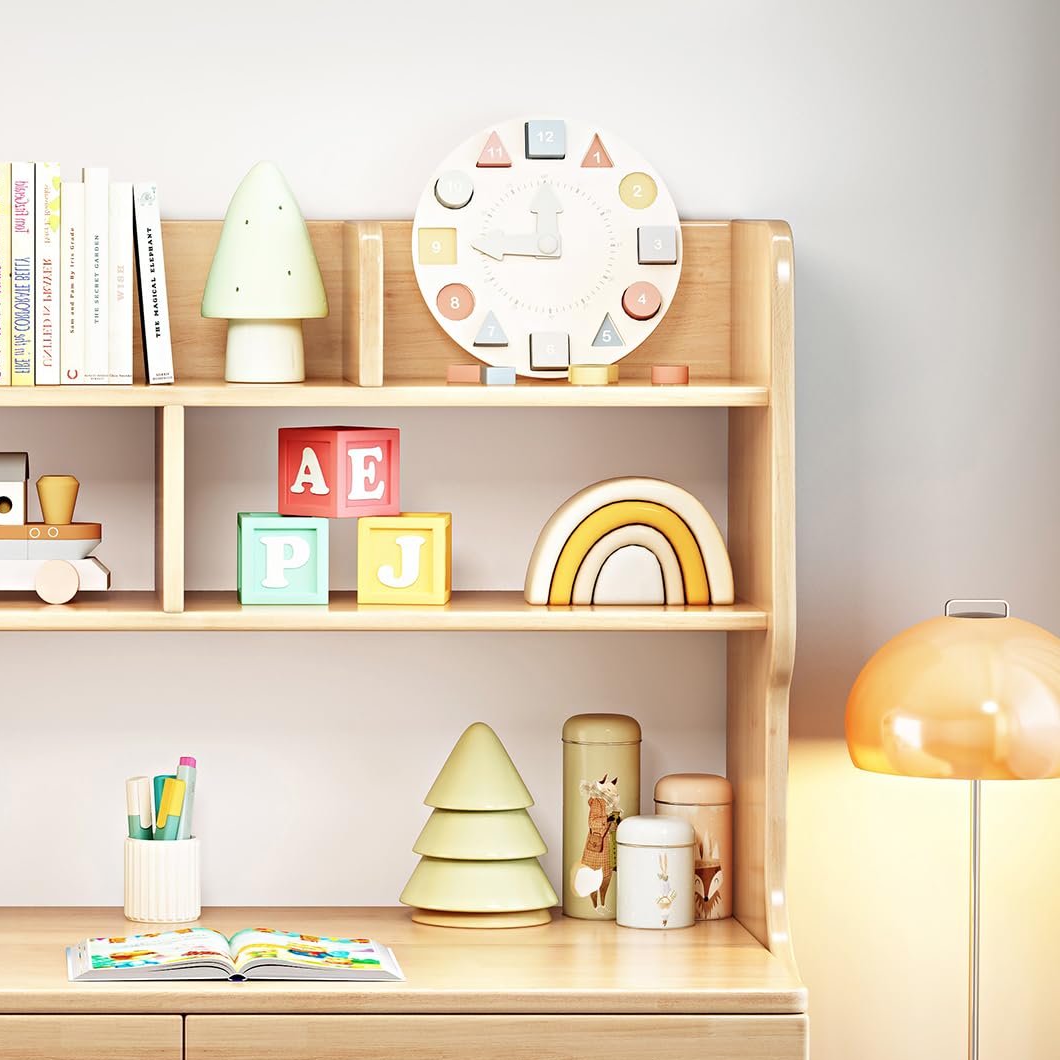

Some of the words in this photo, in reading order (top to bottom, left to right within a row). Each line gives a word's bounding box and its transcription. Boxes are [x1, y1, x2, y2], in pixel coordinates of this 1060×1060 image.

[537, 131, 554, 142] 12
[487, 146, 504, 158] 11
[593, 152, 602, 163] 1
[632, 185, 642, 198] 2
[146, 227, 156, 273] ELEPHANT
[431, 241, 441, 253] 9
[653, 238, 662, 251] 3
[117, 265, 125, 301] WISH
[150, 277, 159, 317] MAGICAL
[450, 297, 460, 309] 8
[637, 293, 646, 305] 4
[487, 325, 494, 337] 7
[602, 330, 611, 342] 5
[290, 447, 330, 495] A
[347, 446, 385, 500] E
[260, 535, 310, 588] P
[377, 535, 426, 588] J
